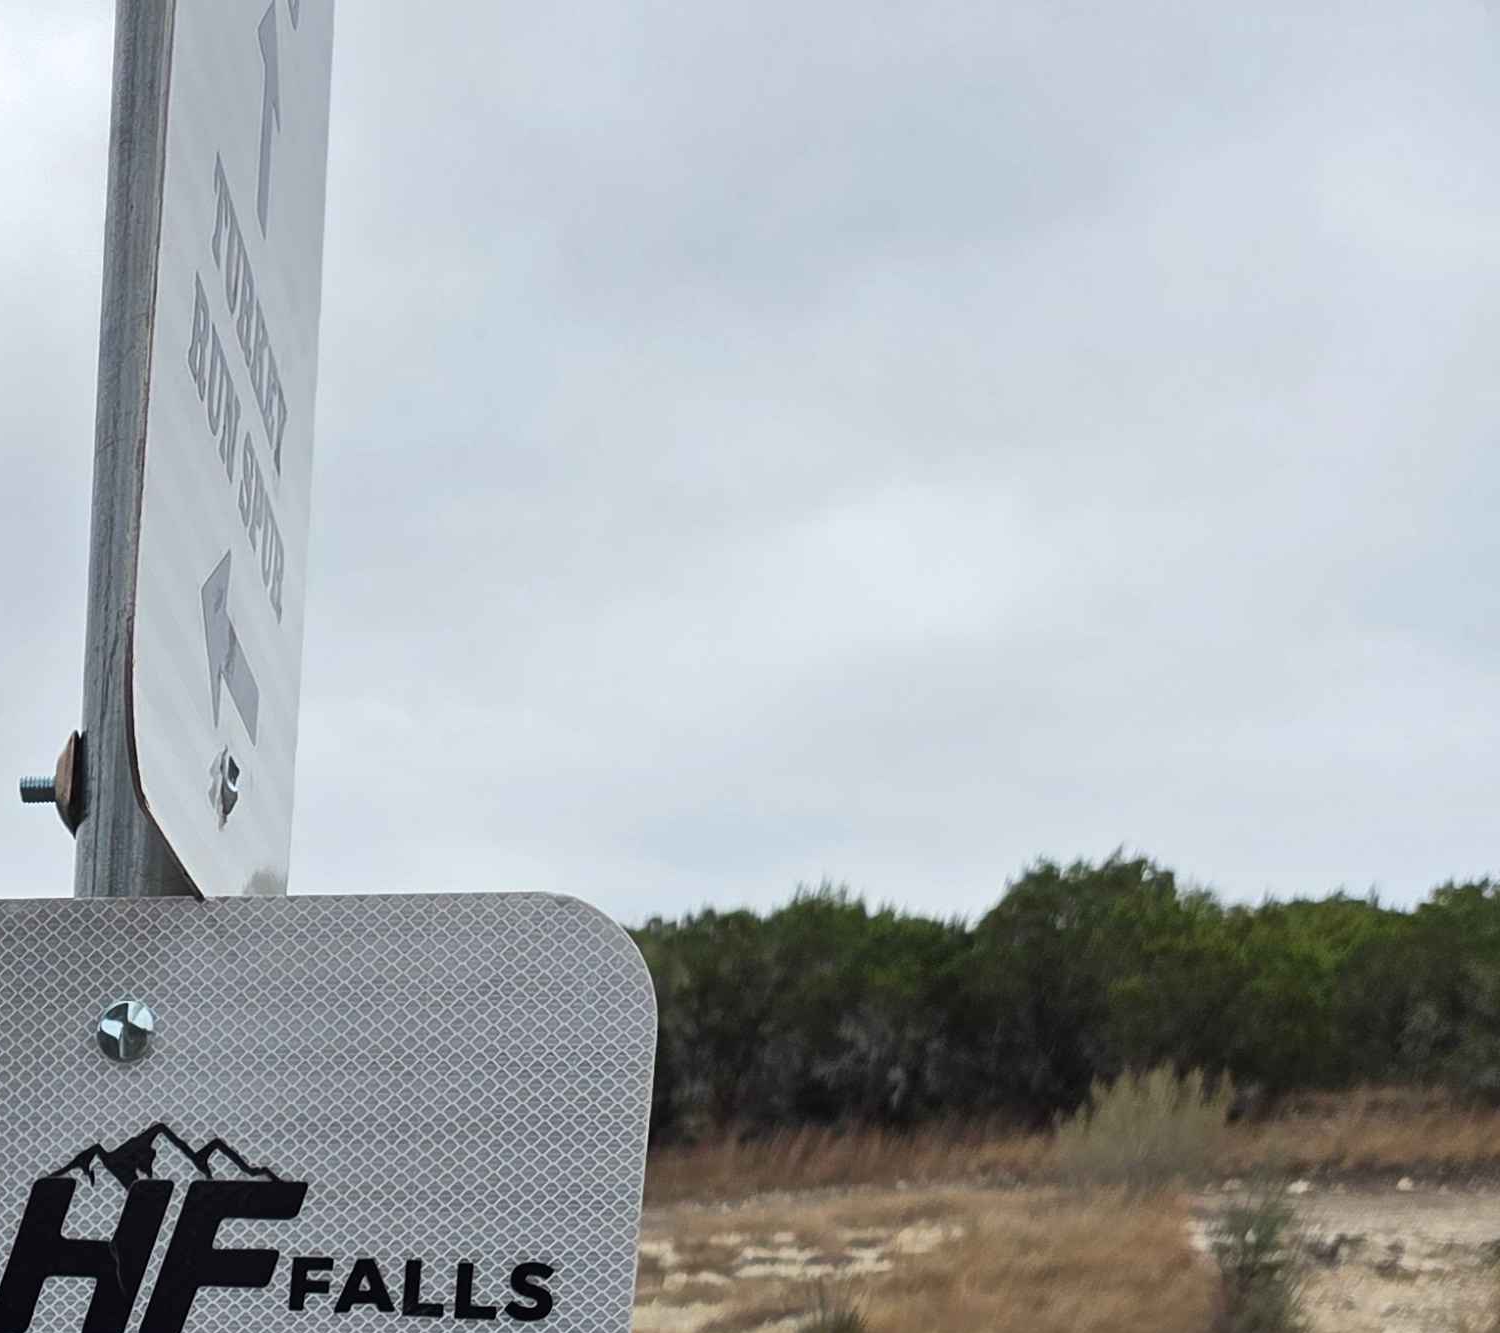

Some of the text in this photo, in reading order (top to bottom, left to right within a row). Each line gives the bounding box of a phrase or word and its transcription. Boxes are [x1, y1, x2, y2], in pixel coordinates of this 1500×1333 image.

[187, 271, 285, 625] RUN SPUR
[212, 151, 287, 477] TURKEY
[288, 1256, 556, 1322] FALLS
